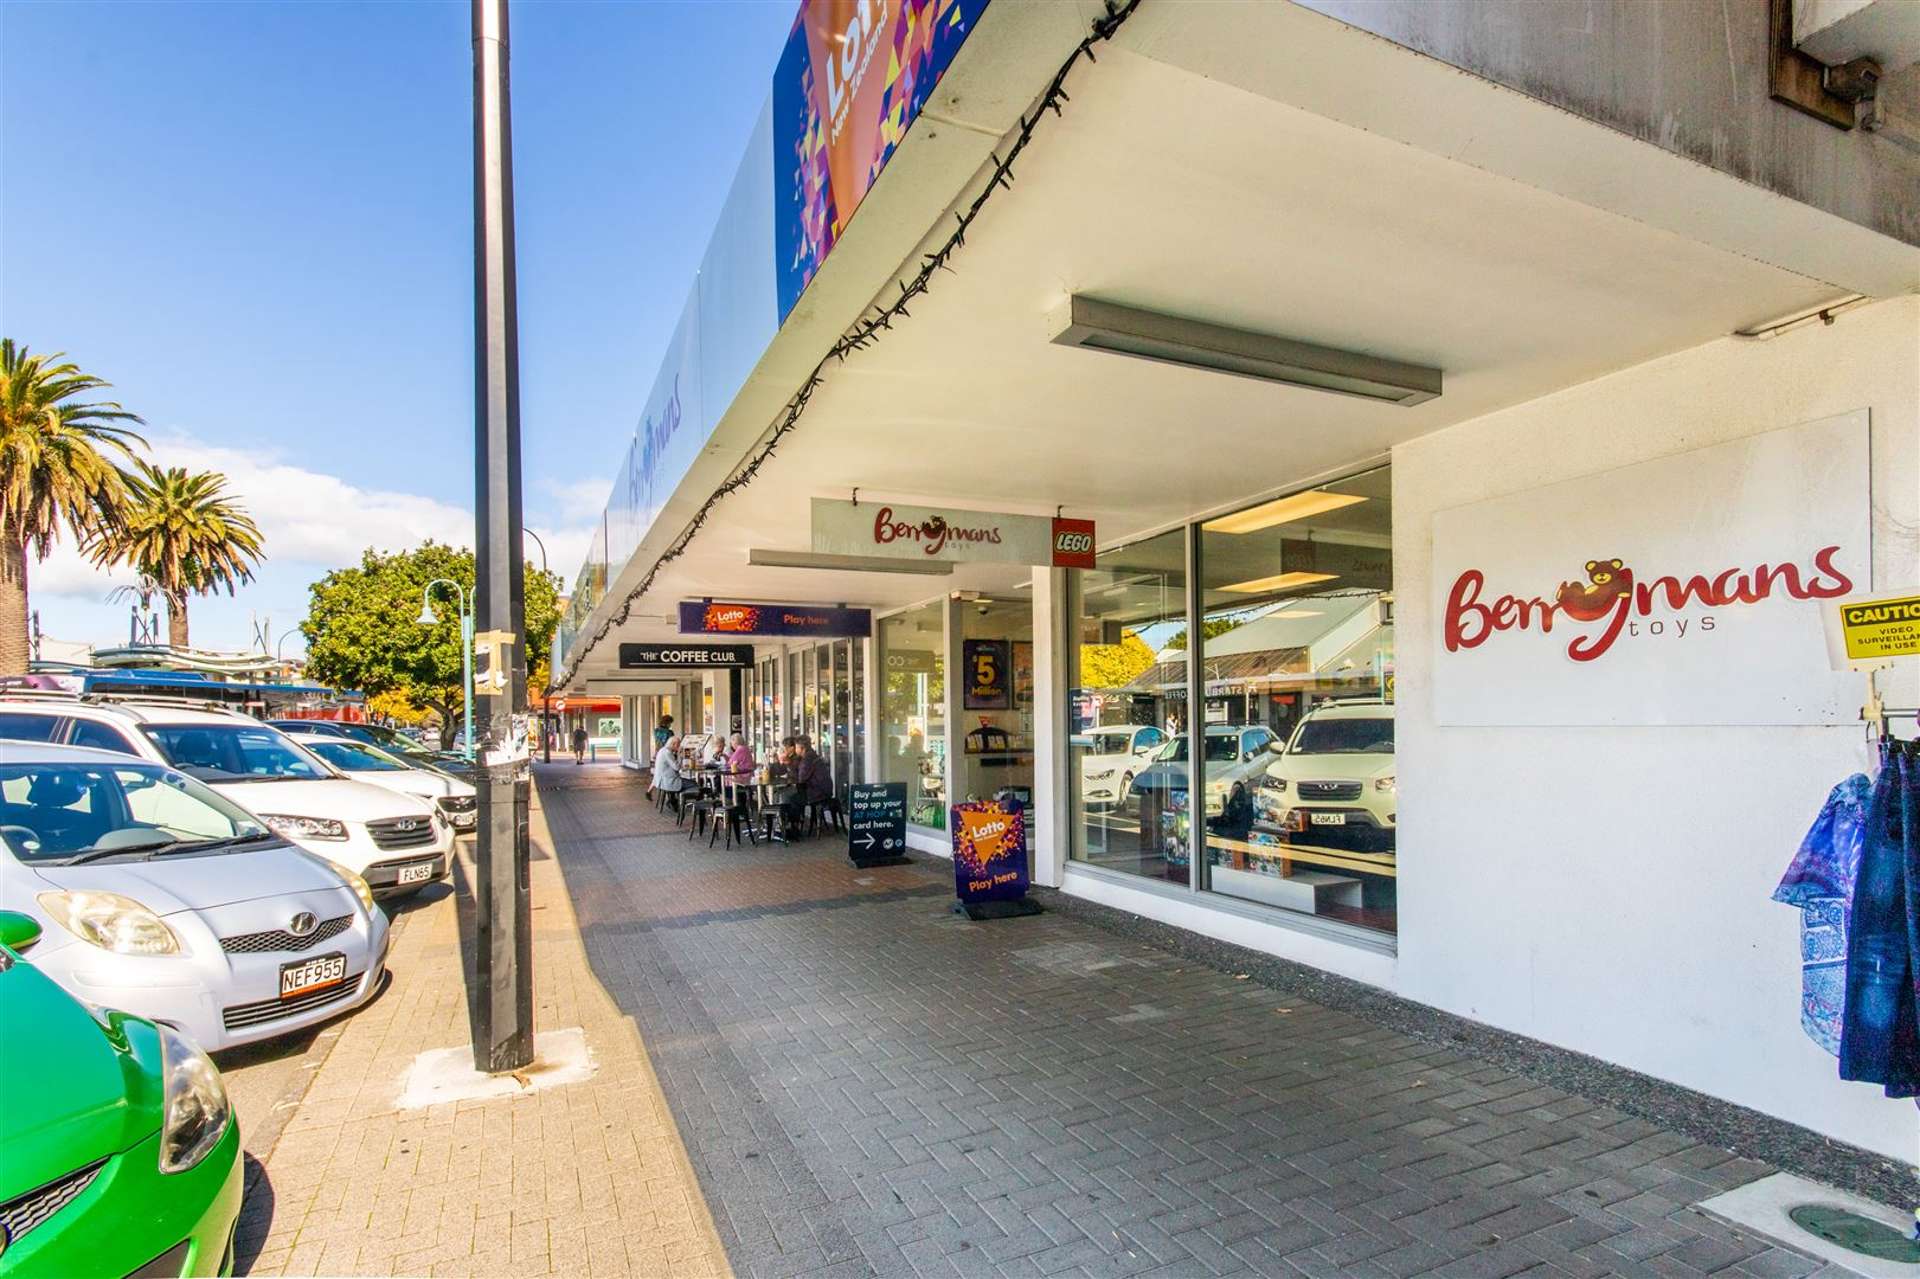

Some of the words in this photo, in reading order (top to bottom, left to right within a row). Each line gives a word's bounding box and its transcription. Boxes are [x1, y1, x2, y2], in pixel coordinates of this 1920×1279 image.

[874, 507, 1002, 555] Berrymans
[1056, 532, 1093, 553] LEGO
[1444, 546, 1853, 661] Berrymans
[717, 610, 744, 622] Lotto
[783, 614, 806, 625] Play
[807, 615, 829, 625] here
[1629, 615, 1716, 638] toys
[1880, 626, 1914, 635] VIDEO
[1895, 641, 1917, 649] USE
[640, 652, 660, 662] THE
[660, 651, 709, 663] COFFEE
[854, 790, 870, 799] Buy
[871, 789, 887, 798] and
[854, 802, 868, 810] top
[883, 801, 902, 809] your
[853, 821, 871, 830] card
[873, 820, 894, 829] here.
[972, 821, 1005, 838] Lotto
[968, 880, 992, 892] Play
[994, 872, 1018, 884] here
[284, 959, 342, 991] NEF955
